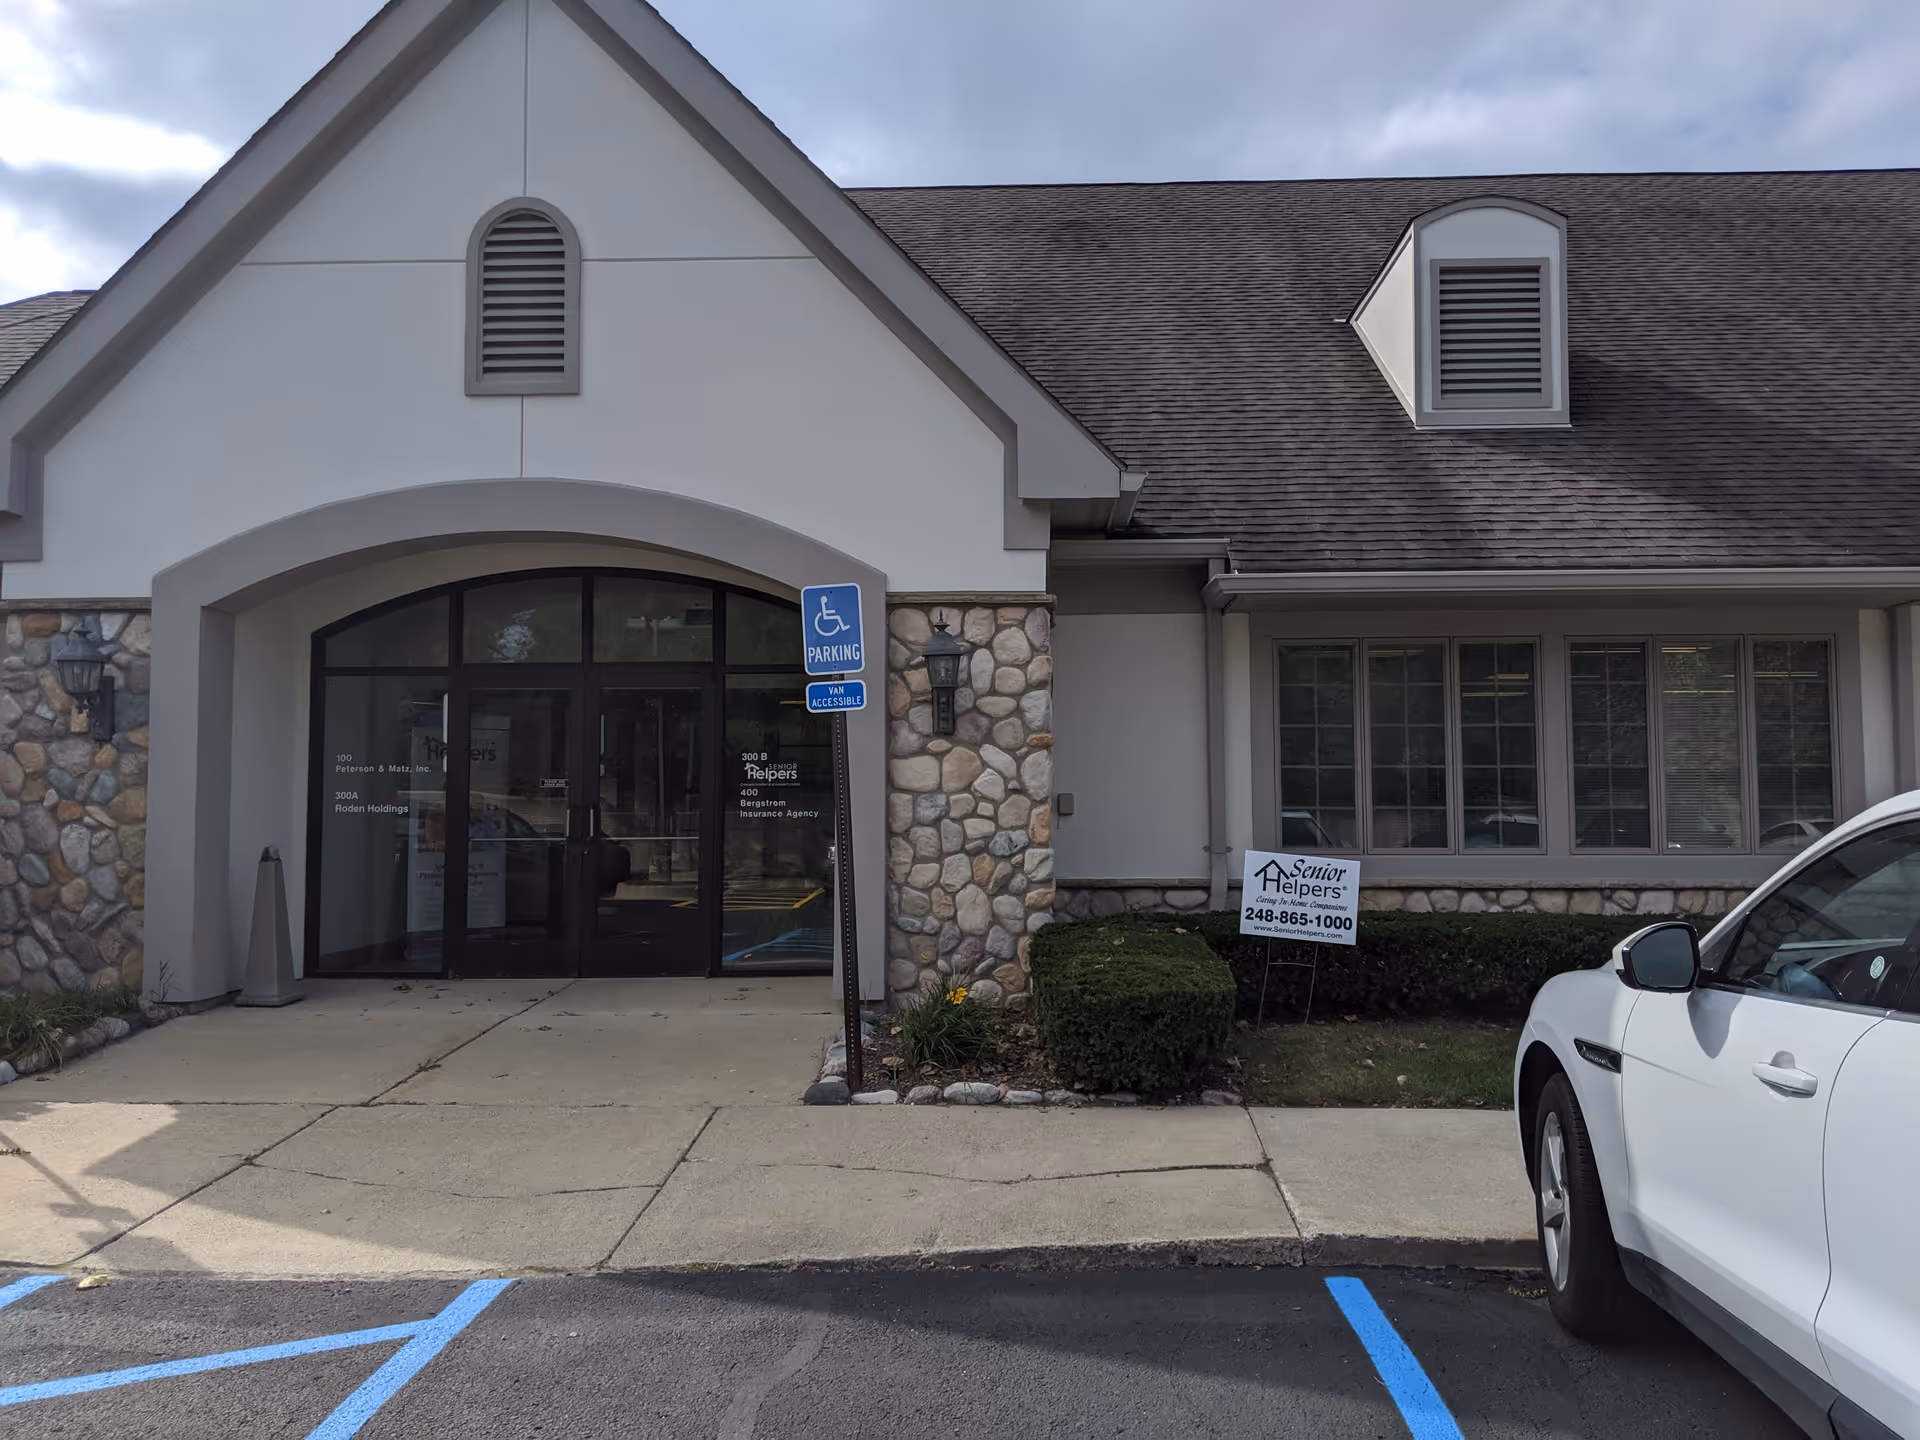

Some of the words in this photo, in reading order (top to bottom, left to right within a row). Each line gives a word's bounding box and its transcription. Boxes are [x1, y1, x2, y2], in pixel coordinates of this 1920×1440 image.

[808, 643, 860, 663] PARKING
[828, 686, 844, 695] VAN
[811, 695, 862, 708] ACCESSIBLE
[336, 754, 352, 762] 100
[741, 752, 758, 761] 300
[760, 752, 768, 761] B
[335, 765, 375, 773] Peterson
[378, 765, 384, 773] &
[388, 765, 413, 774] Matz,
[416, 765, 432, 773] Inc.
[747, 766, 798, 782] Helpers
[335, 791, 359, 800] 300A
[740, 788, 758, 796] 400
[740, 799, 786, 808] Bergstrom
[335, 804, 365, 813] Roden
[367, 804, 409, 815] Holdings
[740, 810, 783, 818] Insurance
[786, 810, 819, 819] Agency
[1289, 858, 1347, 882] Senior
[1255, 895, 1278, 905] Caring
[1278, 897, 1308, 908] In-Home
[1309, 900, 1348, 912] Companions
[1244, 907, 1353, 931] 248-865-1000
[1253, 924, 1343, 939] www.SeniorHelpers.com
